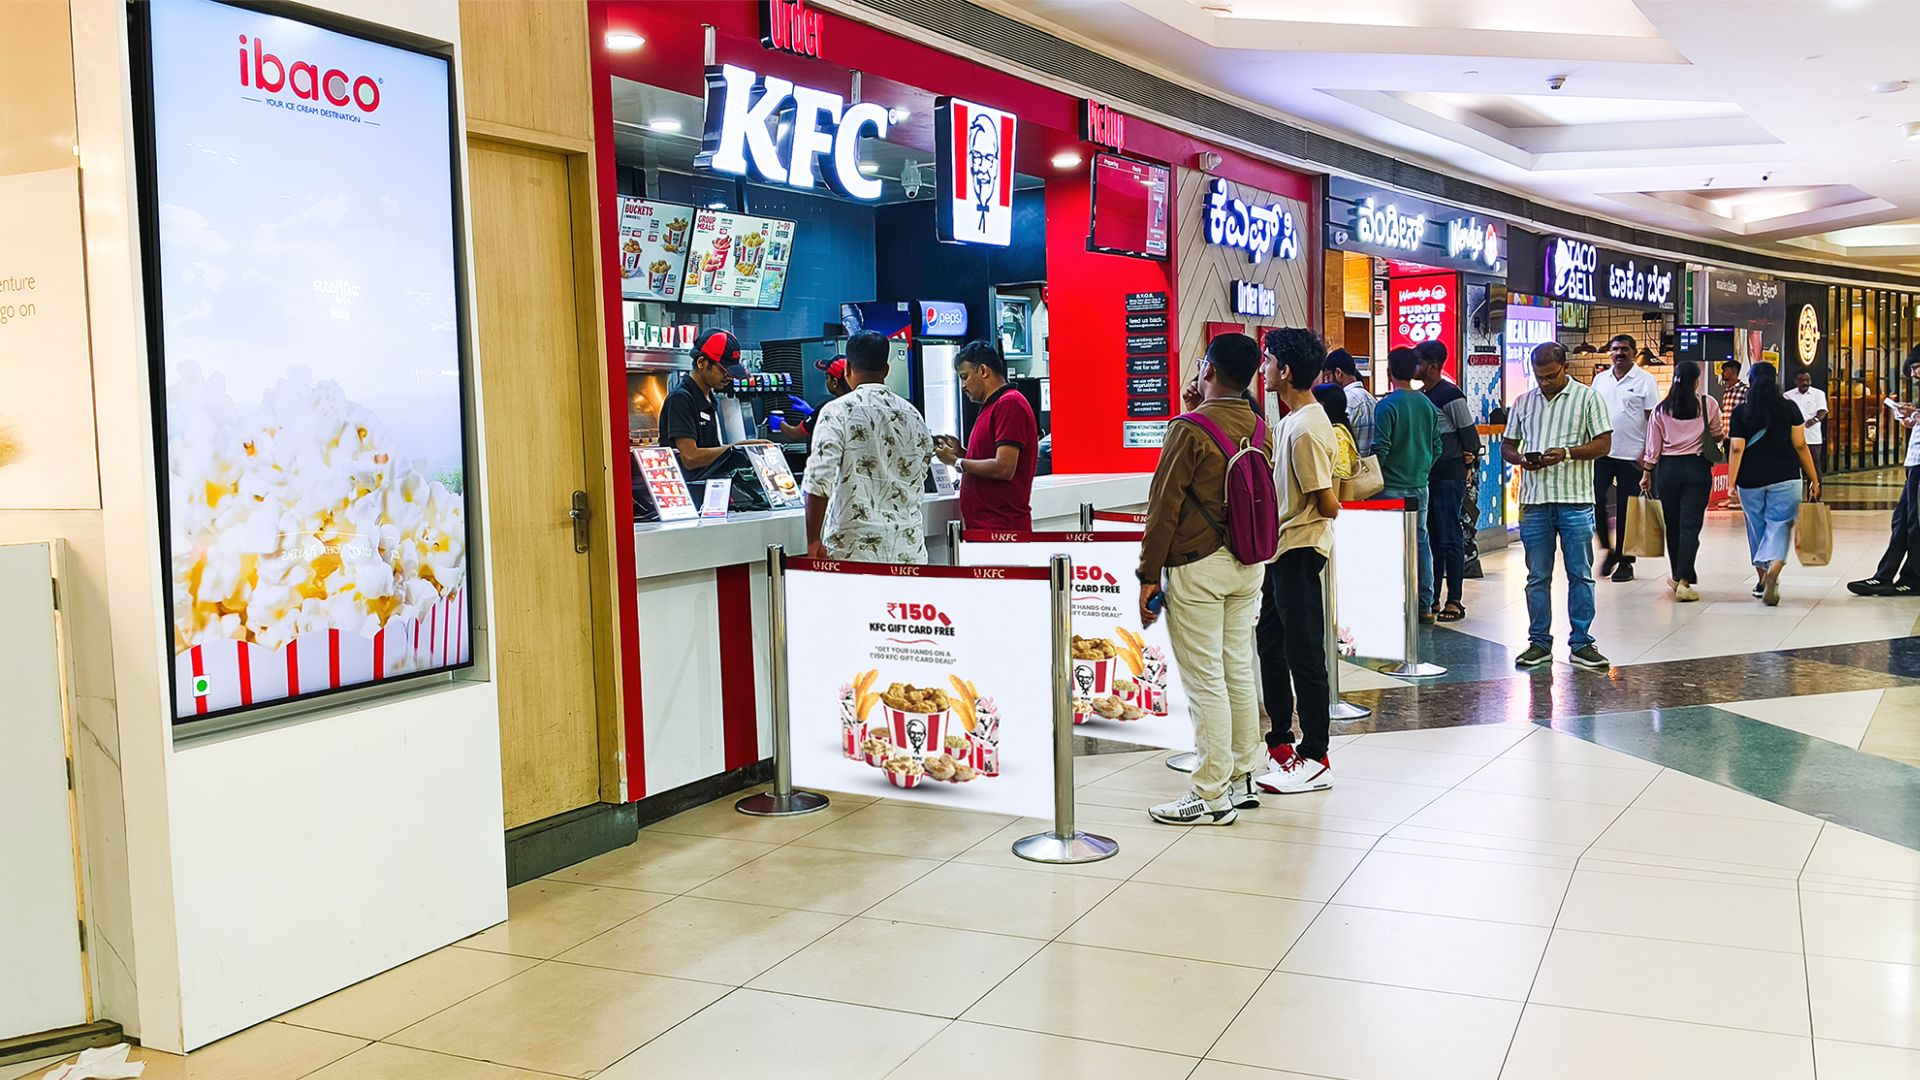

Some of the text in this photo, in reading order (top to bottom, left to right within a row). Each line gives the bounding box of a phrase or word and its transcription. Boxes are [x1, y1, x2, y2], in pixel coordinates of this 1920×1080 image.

[770, 0, 824, 58] Order
[239, 34, 380, 113] ibaco
[266, 98, 361, 123] YOUR ICE CREAM DESTINATION
[711, 62, 890, 199] KFC
[1088, 98, 1125, 154] Pickup
[625, 203, 654, 217] BUCKETS
[1567, 240, 1597, 273] TACO
[1399, 286, 1431, 303] Wendy's
[1568, 271, 1597, 302] BELL
[1237, 279, 1258, 316] Order
[0, 303, 36, 325] go on
[1398, 303, 1446, 316] BURGER
[939, 310, 963, 326] pepsi
[1407, 313, 1441, 324] COKE
[998, 533, 1017, 542] KFC
[1074, 533, 1094, 542] KFC
[820, 562, 840, 572] KFC
[899, 566, 919, 576] KFC
[983, 569, 1005, 579] KFC
[1075, 584, 1099, 593] CARD
[1100, 585, 1121, 594] FREE
[886, 602, 937, 621] ₹150
[869, 622, 955, 636] KFC GIFT CARD FREE
[1179, 803, 1205, 818] PUMA
